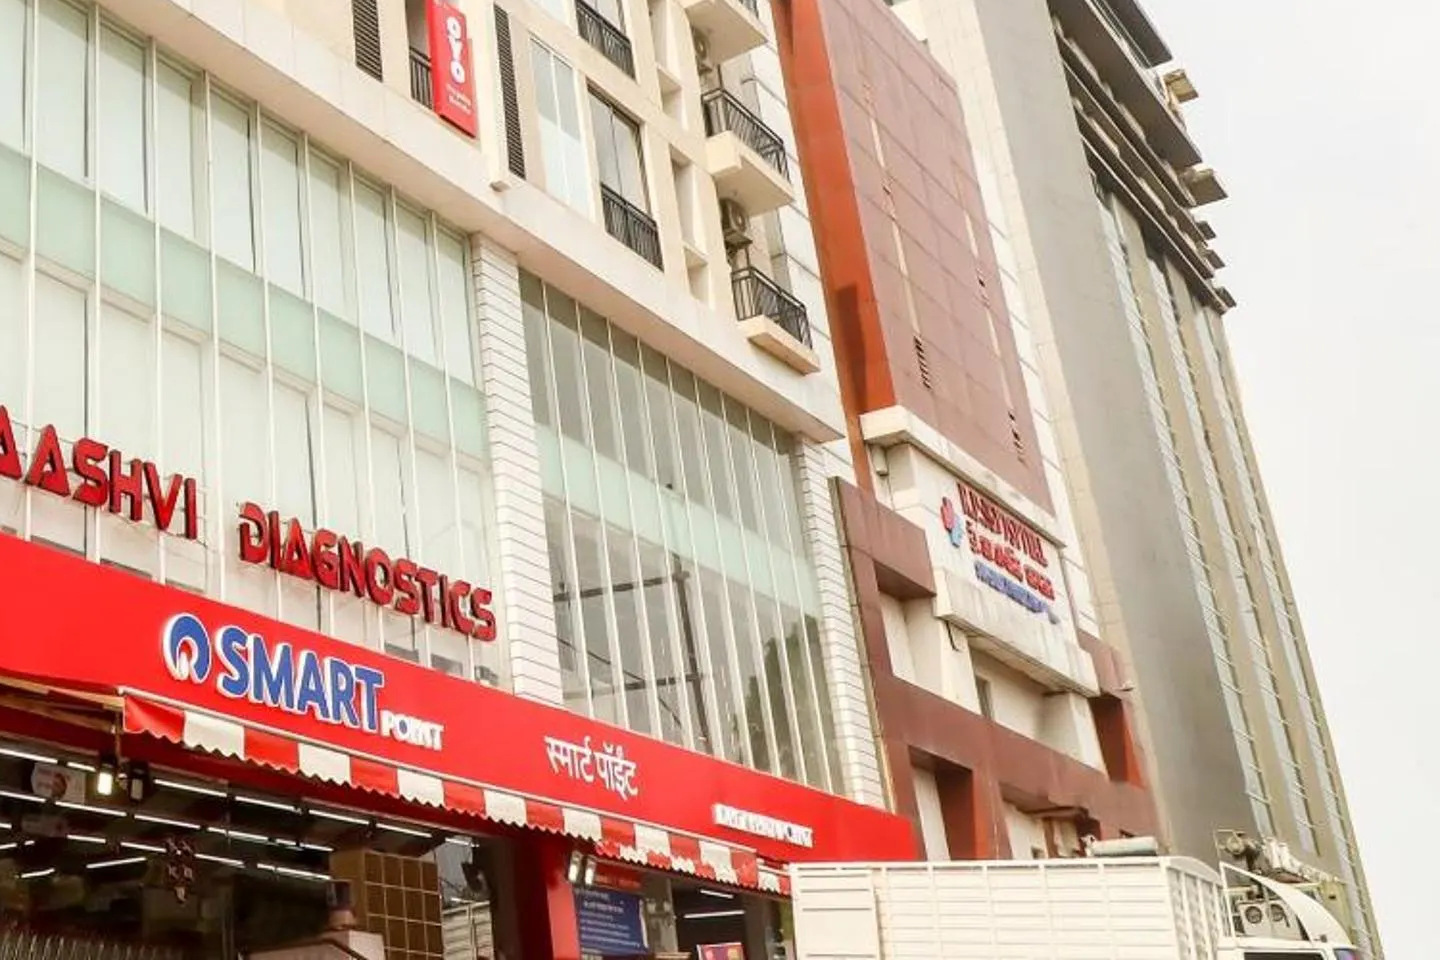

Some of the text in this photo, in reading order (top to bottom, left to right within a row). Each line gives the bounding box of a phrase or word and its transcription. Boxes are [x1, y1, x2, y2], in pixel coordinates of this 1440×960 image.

[446, 16, 466, 84] OYO
[238, 501, 496, 642] DIAGNOSTICS
[215, 625, 445, 751] SMART POINT
[544, 735, 594, 783] स्मार्ट
